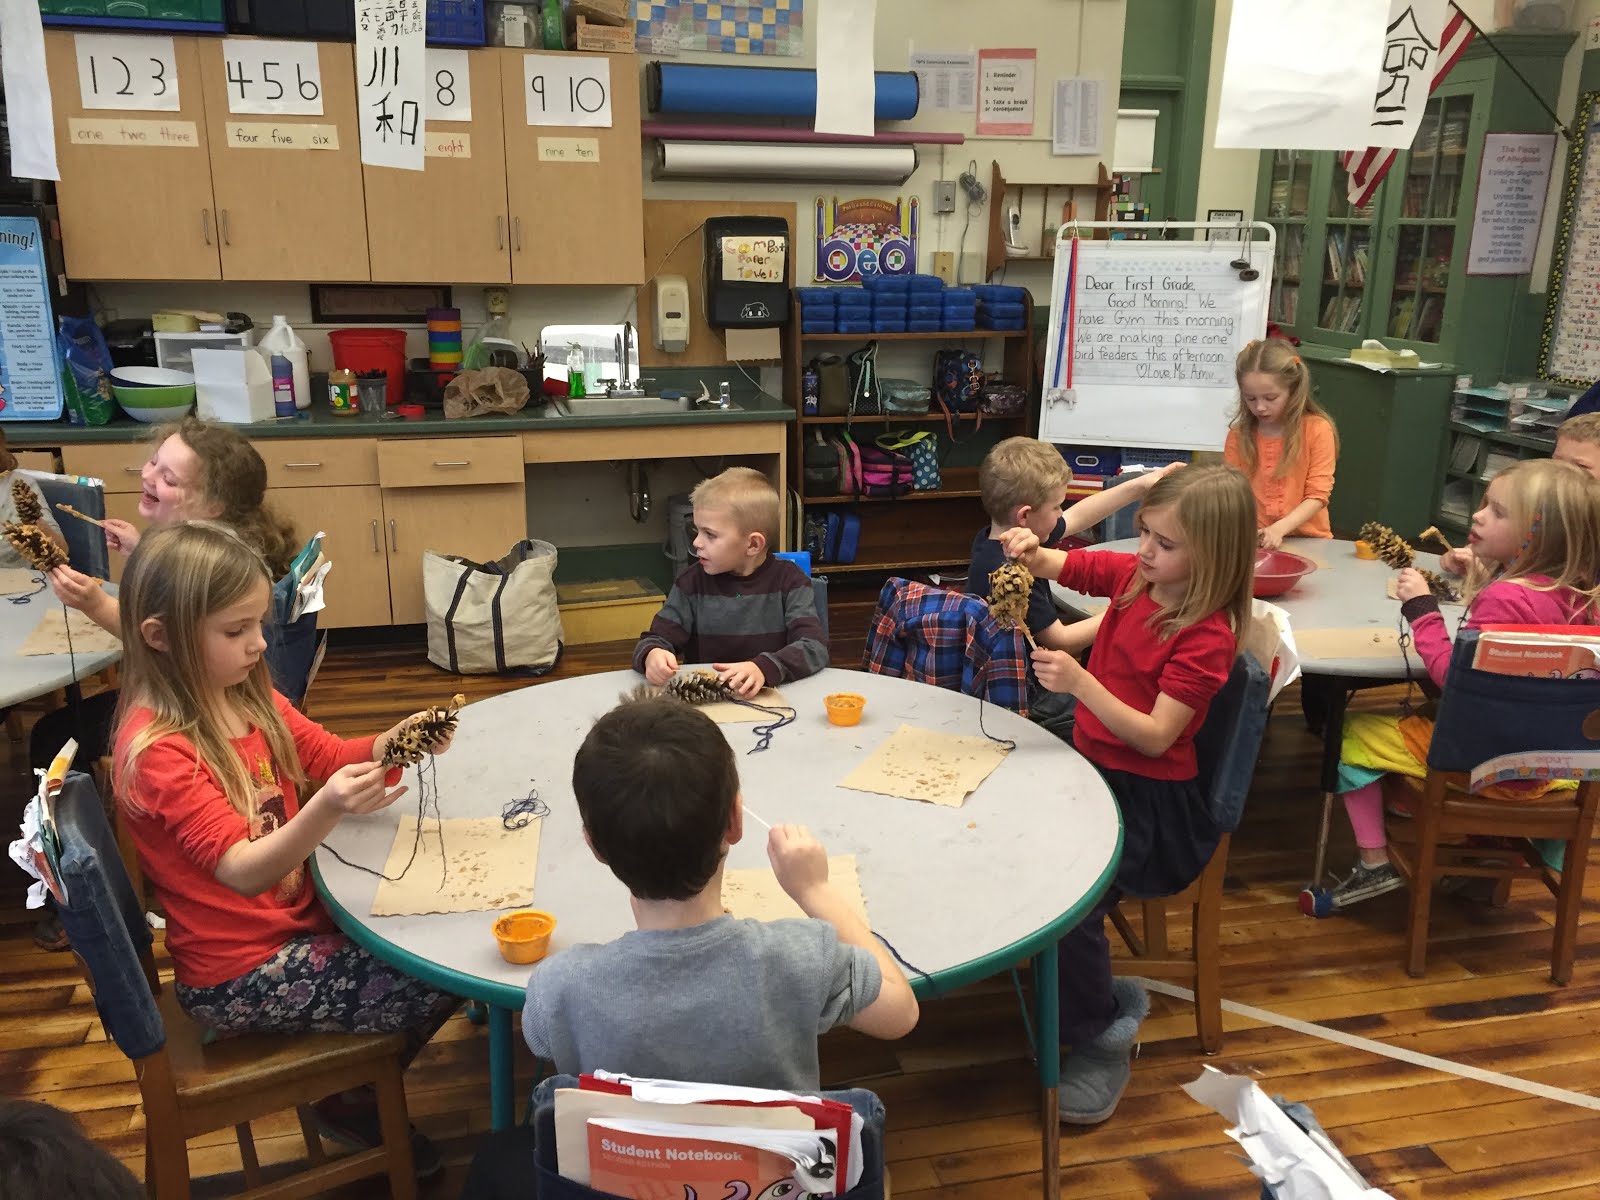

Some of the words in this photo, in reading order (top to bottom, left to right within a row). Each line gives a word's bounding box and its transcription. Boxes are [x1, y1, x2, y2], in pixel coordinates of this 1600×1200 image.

[90, 55, 98, 94] 1
[112, 56, 134, 95] 2
[149, 57, 167, 96] 3
[226, 60, 253, 99] 4
[262, 62, 284, 99] 5
[296, 63, 319, 101] 6
[435, 69, 456, 106] 8
[531, 75, 546, 111] 9
[569, 76, 606, 113] 10
[993, 85, 1015, 93] Warning
[77, 129, 103, 140] one
[120, 126, 148, 140] two
[159, 125, 190, 142] three
[235, 131, 259, 143] four
[271, 129, 293, 145] five
[312, 132, 330, 145] six
[437, 139, 465, 158] eight
[545, 147, 565, 157] nine
[575, 147, 594, 158] ten
[1085, 275, 1114, 290] Dear
[1125, 275, 1154, 290] First
[1108, 293, 1136, 308] Good
[1143, 293, 1188, 313] Morning!
[1198, 293, 1217, 309] We
[1078, 310, 1104, 325] have
[1113, 309, 1145, 329] Gym
[1154, 309, 1179, 326] this
[1185, 316, 1234, 335] morning
[1077, 328, 1092, 343] We
[1097, 333, 1114, 343] are
[1120, 330, 1163, 347] making
[1174, 333, 1198, 348] pine
[1201, 335, 1227, 345] cone
[1074, 346, 1094, 361] bird
[1098, 346, 1138, 361] feeders
[1145, 347, 1167, 362] this
[601, 1138, 661, 1160] Student
[666, 1148, 742, 1161] Notebook
